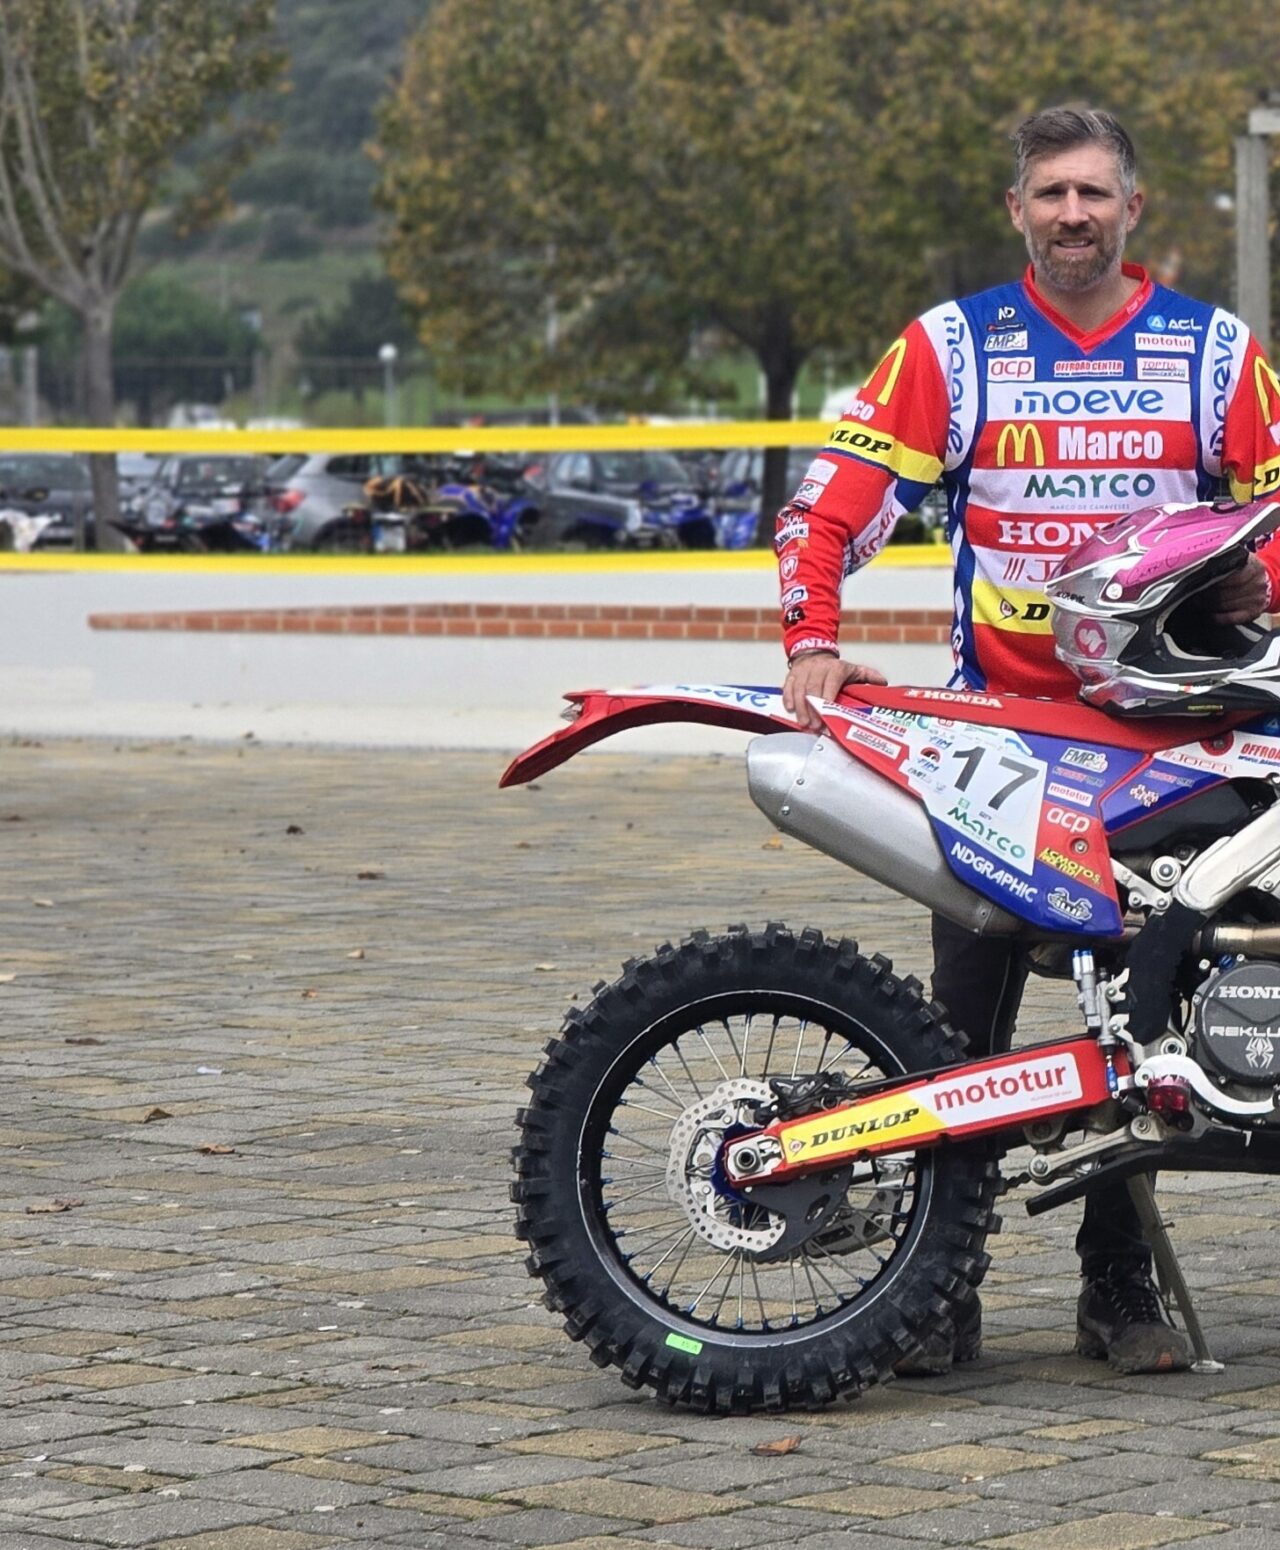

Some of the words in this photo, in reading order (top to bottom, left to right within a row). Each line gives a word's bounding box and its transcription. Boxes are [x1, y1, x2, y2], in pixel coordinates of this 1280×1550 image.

[1168, 318, 1202, 331] ACL
[1138, 336, 1191, 347] mototur
[991, 360, 1032, 378] acp
[1055, 361, 1090, 371] OFFROAD
[1092, 360, 1122, 371] CENTER
[944, 316, 965, 454] moeve
[1014, 389, 1164, 415] moeve
[1057, 426, 1163, 461] Marco
[998, 521, 1110, 547] HON
[924, 690, 1003, 709] HONDA
[952, 746, 1039, 811] 17
[1050, 784, 1090, 803] mototur
[1046, 807, 1090, 833] acp
[951, 841, 1039, 904] NDGRAPHIC
[933, 1064, 1068, 1112] mototur
[810, 1107, 920, 1148] DUNLOP
